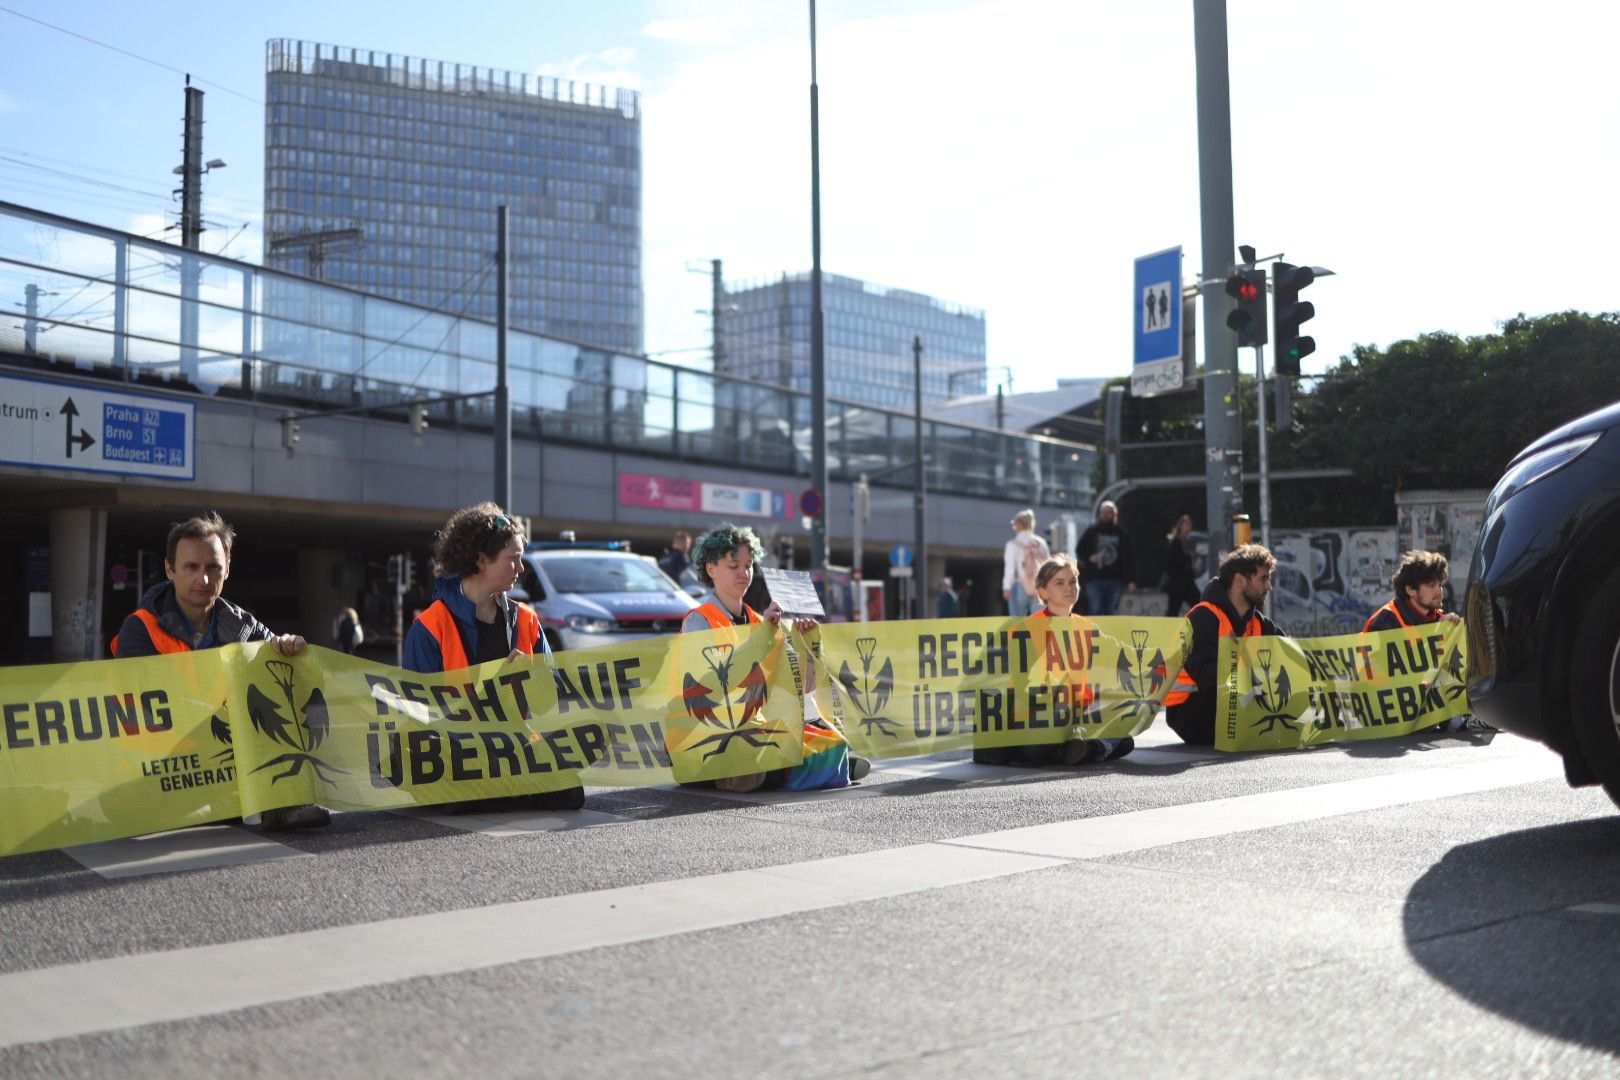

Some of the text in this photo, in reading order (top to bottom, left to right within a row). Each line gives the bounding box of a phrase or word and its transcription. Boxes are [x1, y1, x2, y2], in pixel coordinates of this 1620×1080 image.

[0, 403, 38, 420] trum
[106, 406, 139, 423] Praha
[106, 425, 133, 441] Brno
[105, 444, 150, 463] Budapest
[918, 630, 1100, 679] RECHT AUF
[1303, 634, 1444, 681] RECHT AUF
[364, 656, 641, 723] RECHT AUF
[912, 683, 1102, 739] ÜBERLEBEN
[0, 690, 173, 750] ERUNG
[141, 754, 200, 777] LETZTE
[366, 720, 673, 789] ÜBERLEBEN
